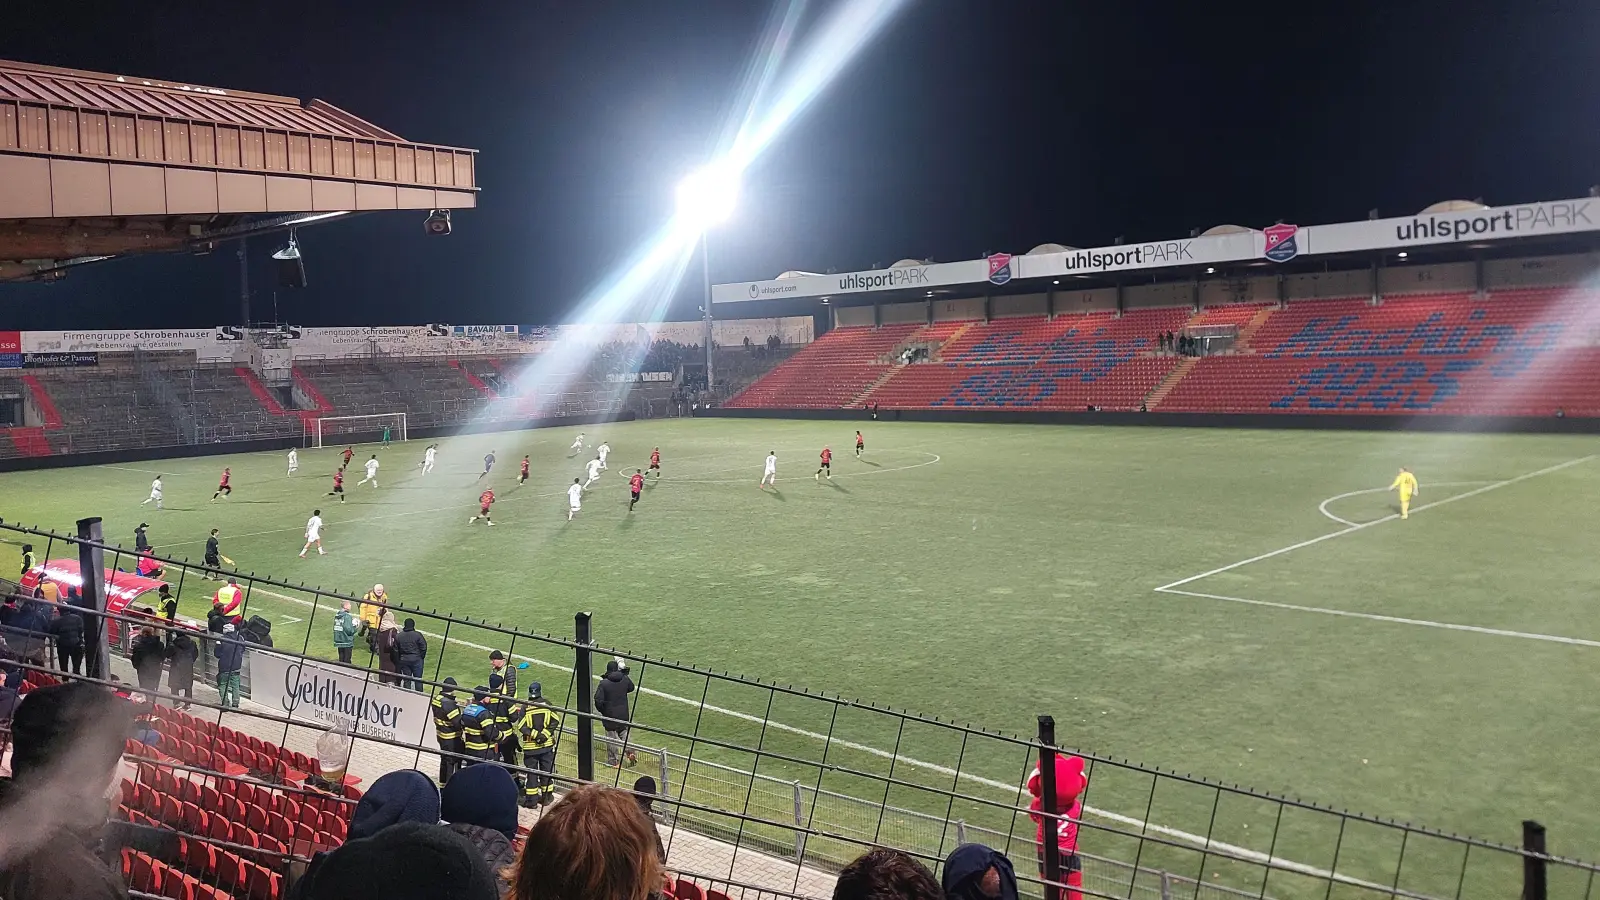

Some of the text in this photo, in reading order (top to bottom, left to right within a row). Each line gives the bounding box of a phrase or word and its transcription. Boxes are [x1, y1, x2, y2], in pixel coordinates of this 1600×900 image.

[1396, 202, 1592, 240] uhlsportPARK
[1065, 241, 1193, 270] uhlsportPARK
[839, 267, 929, 291] uhlsportPARK
[761, 285, 797, 294] uhlsport.com
[63, 331, 210, 341] Firmengruppe Schrobenhauser
[467, 325, 502, 333] BAVARIA
[149, 340, 182, 349] gestalten
[71, 354, 97, 363] Partner
[282, 664, 403, 728] Geldhauser
[314, 708, 324, 720] DIE
[362, 723, 396, 741] BUSREISEN
